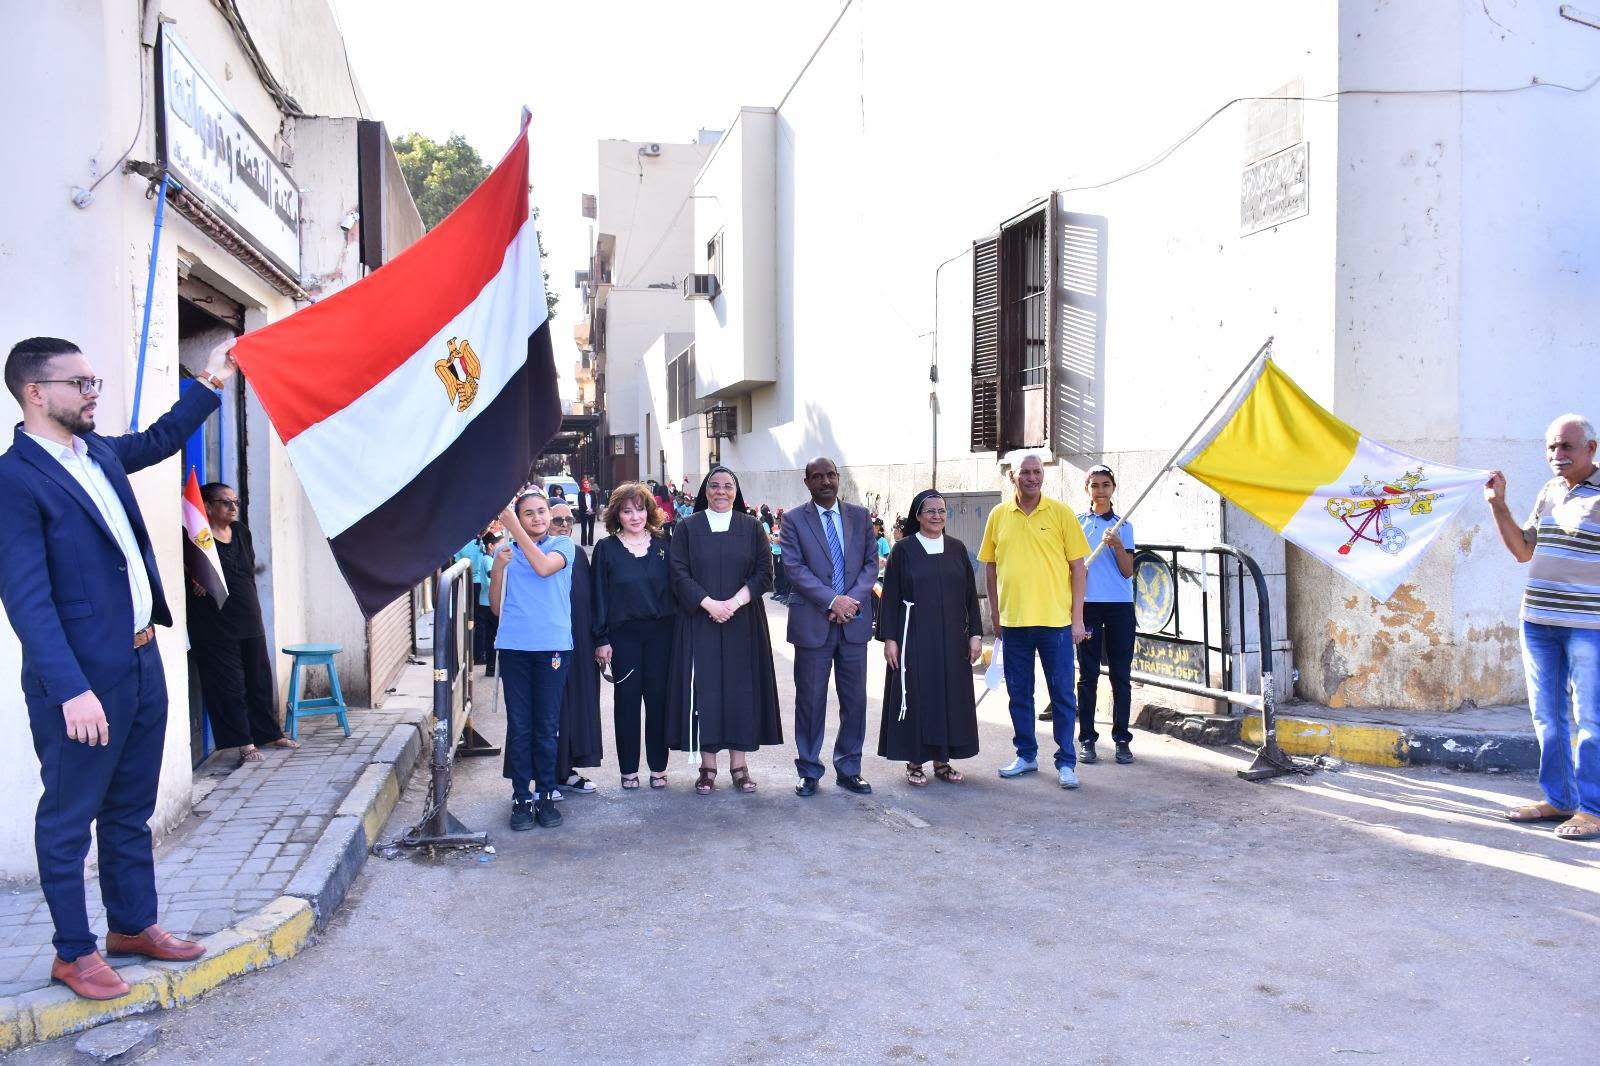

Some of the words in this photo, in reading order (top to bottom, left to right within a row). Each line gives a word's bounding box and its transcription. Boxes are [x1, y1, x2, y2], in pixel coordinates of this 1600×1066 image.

[236, 132, 271, 210] النهضة
[275, 178, 298, 238] مكتبة
[1139, 659, 1174, 676] TRAFFIC
[1176, 667, 1200, 680] DEPT
